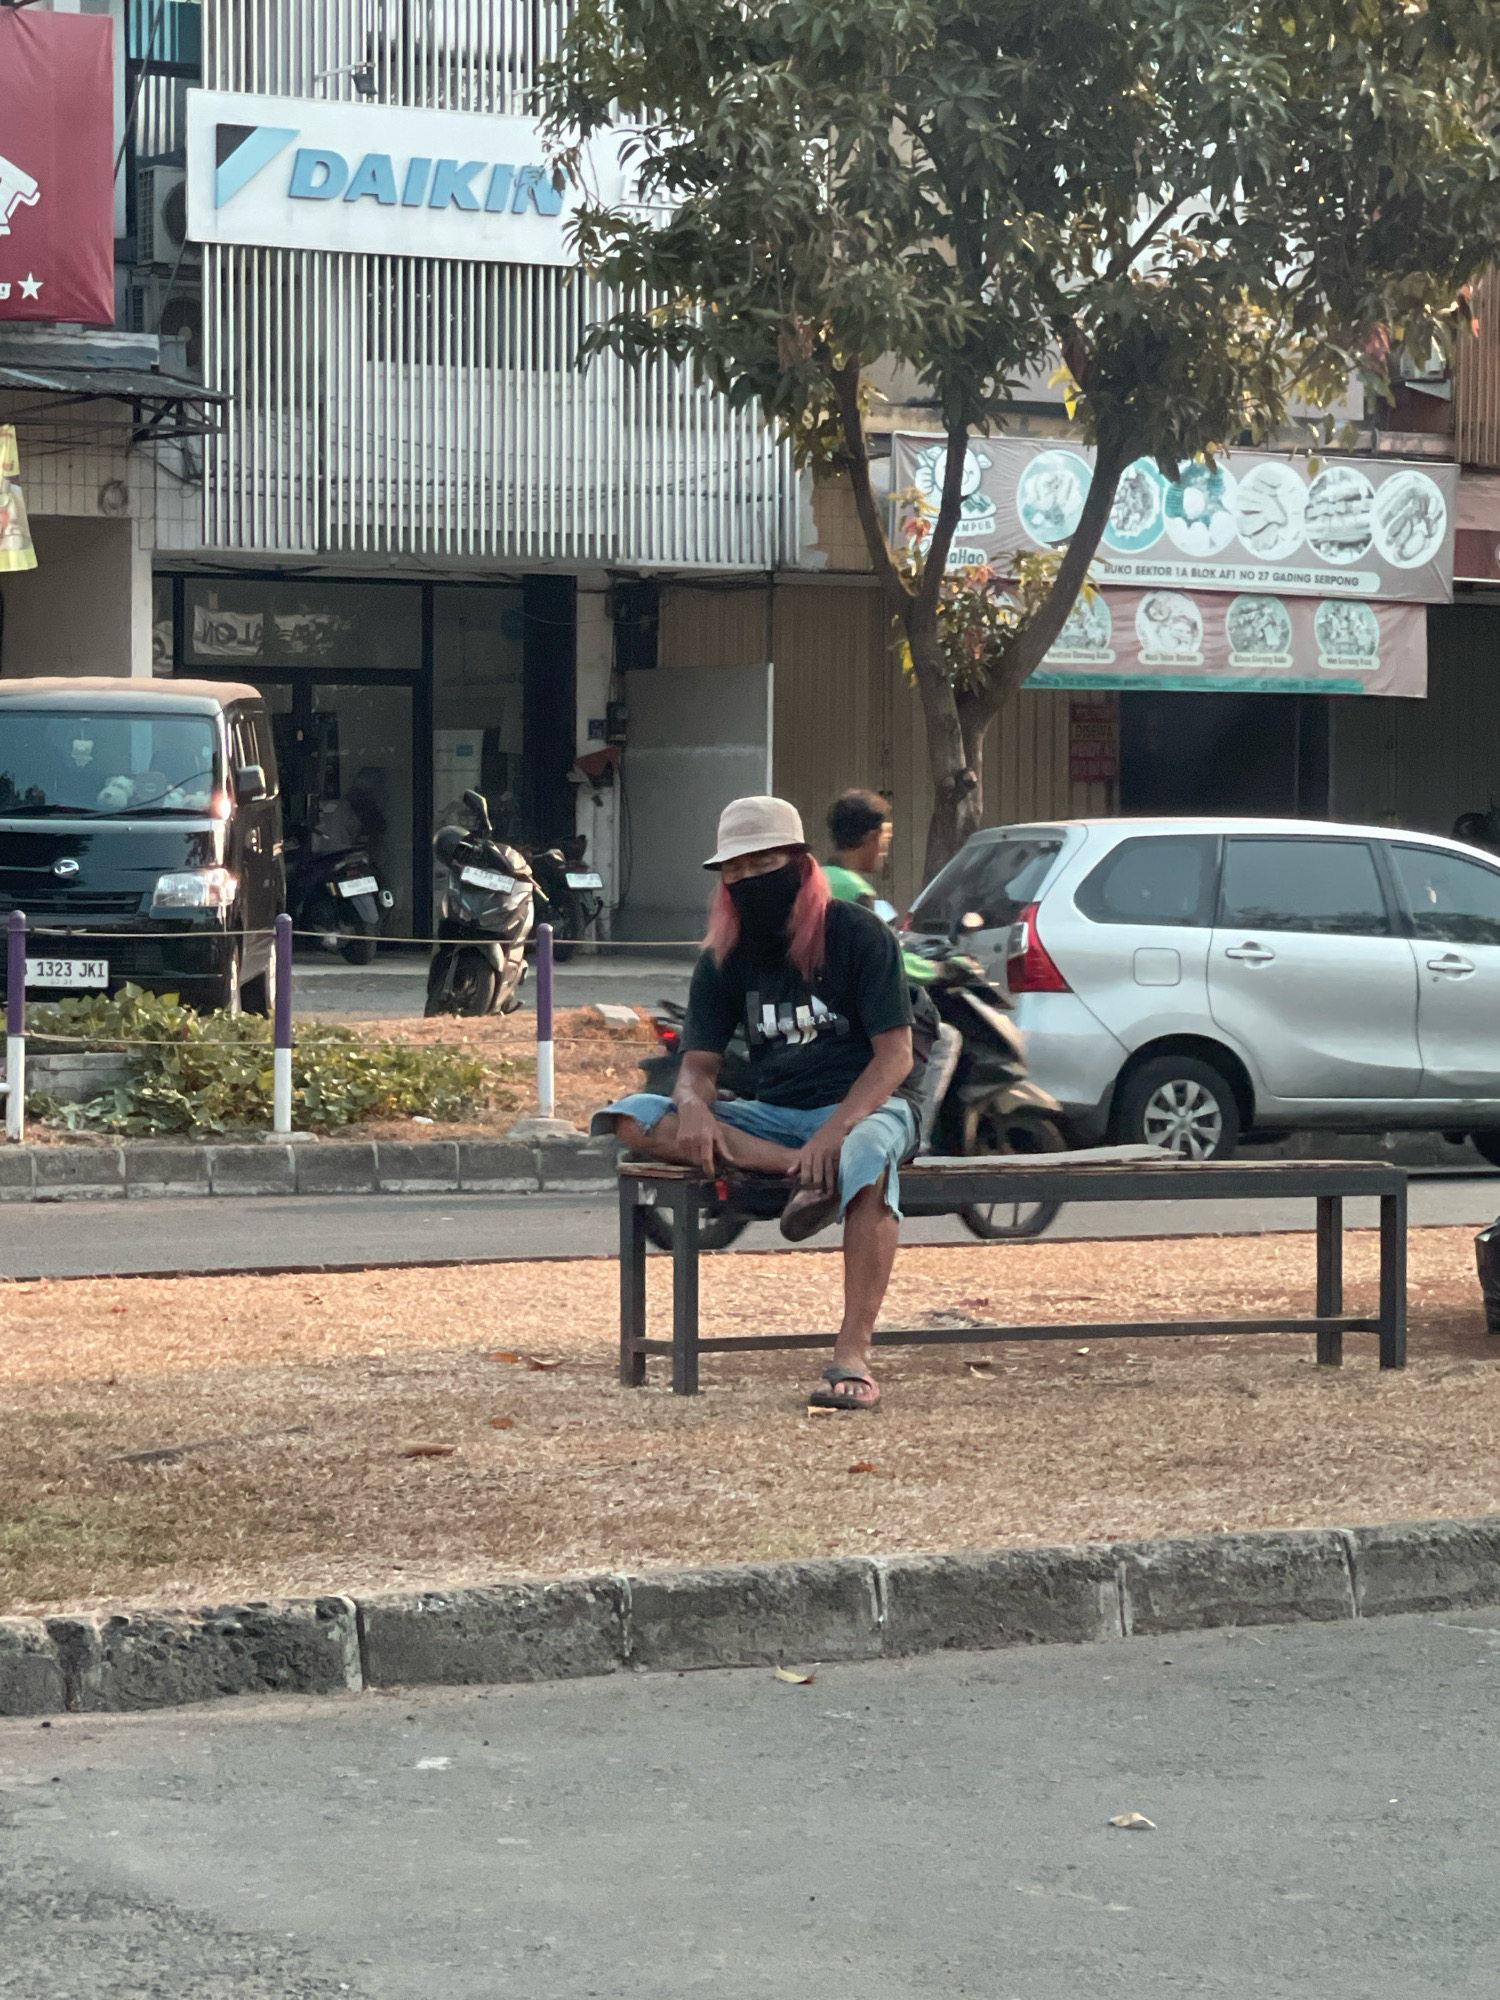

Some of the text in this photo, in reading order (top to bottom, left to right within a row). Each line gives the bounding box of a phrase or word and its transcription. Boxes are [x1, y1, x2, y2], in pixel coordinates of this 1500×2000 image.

[287, 148, 568, 216] DAIKIN
[1104, 564, 1132, 575] RUKO
[1135, 565, 1173, 576] SEKTOR
[1176, 567, 1188, 577] 1A
[1191, 568, 1216, 578] BLOK
[1239, 570, 1255, 580] NO
[1258, 571, 1269, 581] 27
[1272, 572, 1312, 583] GADING
[1314, 574, 1360, 586] SERPONG
[37, 961, 72, 977] 1323
[79, 962, 105, 978] JKI
